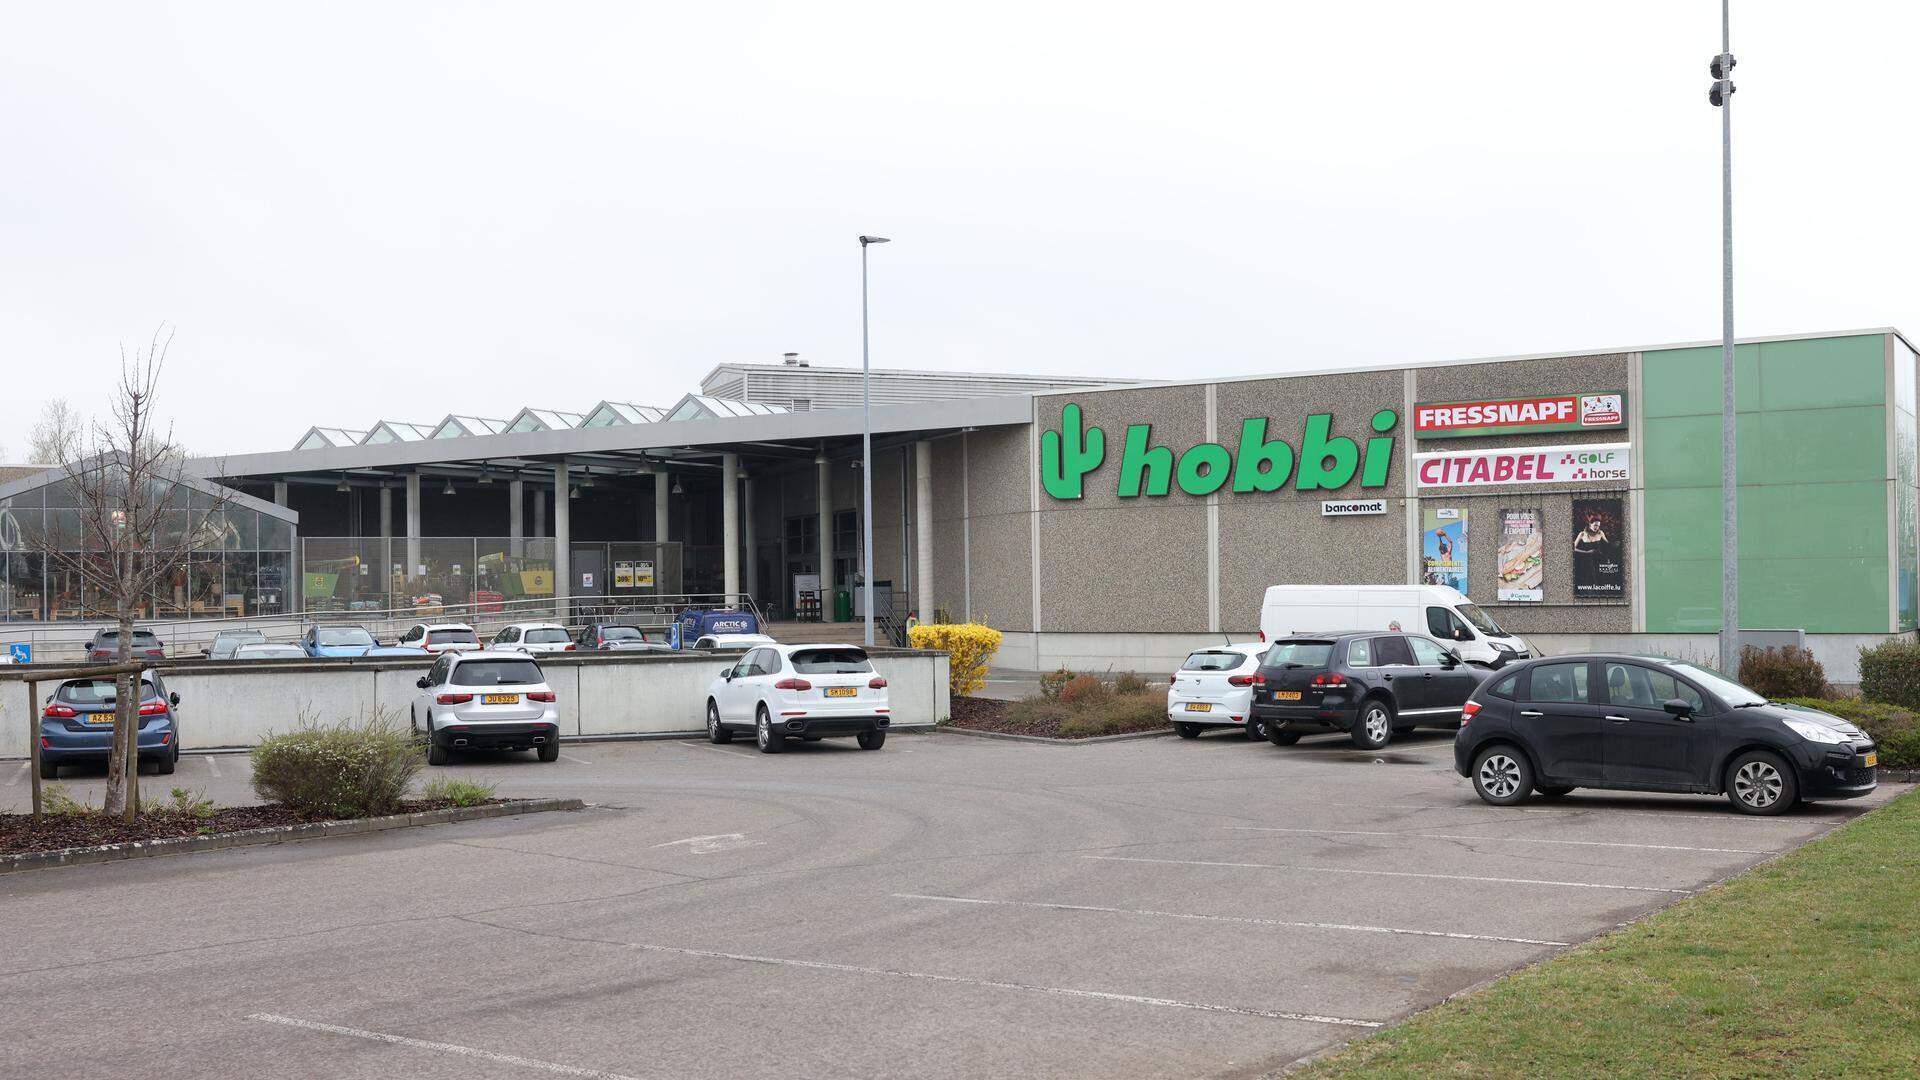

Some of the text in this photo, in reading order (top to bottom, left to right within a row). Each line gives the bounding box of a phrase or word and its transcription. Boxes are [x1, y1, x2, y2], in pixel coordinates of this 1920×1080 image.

[1419, 400, 1573, 427] FRESSNAPF
[1584, 415, 1619, 423] FRESSNAPF
[1117, 409, 1398, 498] hobbi
[1419, 452, 1615, 484] CITABEL GOLF
[1589, 468, 1626, 479] horse
[1325, 502, 1383, 513] bancomat
[1577, 583, 1621, 591] www.lacoiffe.lu
[712, 620, 740, 630] ARCTIC
